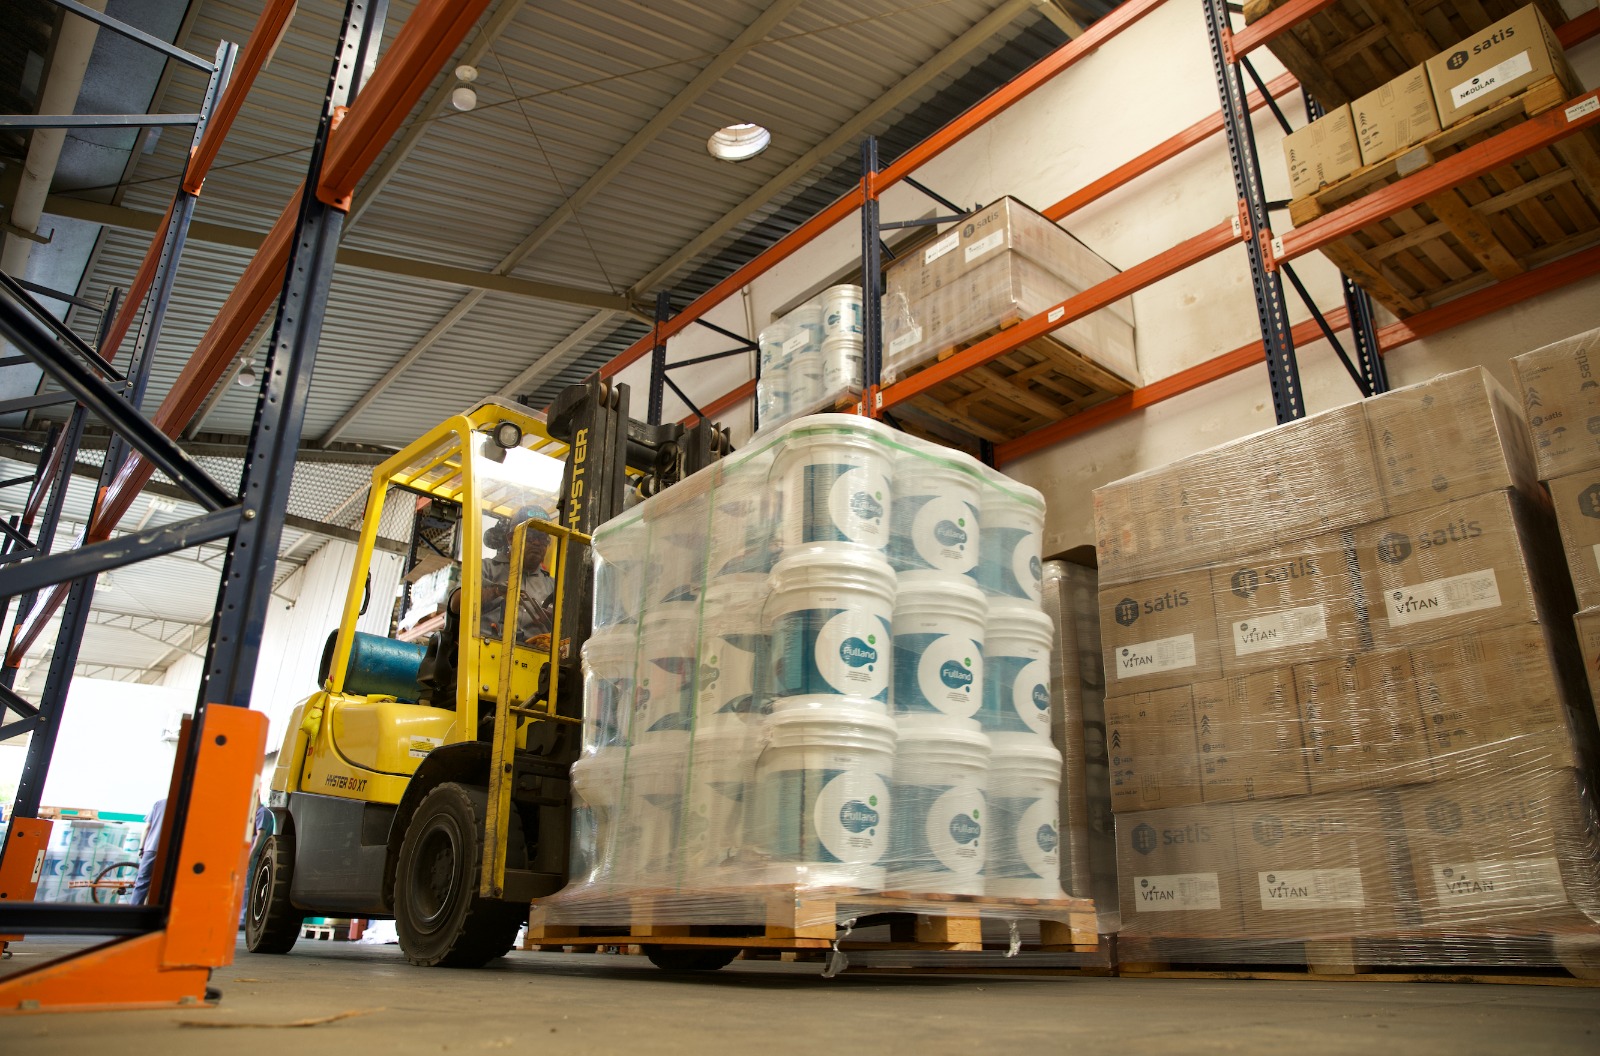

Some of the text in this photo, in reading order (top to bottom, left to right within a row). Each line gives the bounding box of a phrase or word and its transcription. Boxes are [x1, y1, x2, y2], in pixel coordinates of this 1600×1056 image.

[1473, 26, 1515, 55] satis
[1460, 77, 1495, 99] NODULAR
[976, 211, 999, 229] satis
[1576, 348, 1592, 379] satis
[1543, 411, 1563, 422] satis
[568, 427, 589, 533] HYSTER
[1418, 518, 1482, 549] satis
[1264, 557, 1316, 583] satis
[1143, 589, 1189, 615] satis
[1396, 596, 1438, 613] VITAN
[1241, 628, 1277, 644] VITAN
[842, 646, 876, 660] Fulland
[1122, 653, 1153, 668] VITAN
[943, 669, 972, 681] Fulland
[325, 774, 368, 792] HYSTER 50 XT
[842, 811, 876, 823] Fulland
[1162, 823, 1212, 846] satis
[1268, 881, 1308, 898] VITAN
[1446, 874, 1494, 894] VITAN
[1142, 886, 1174, 901] VITAN
